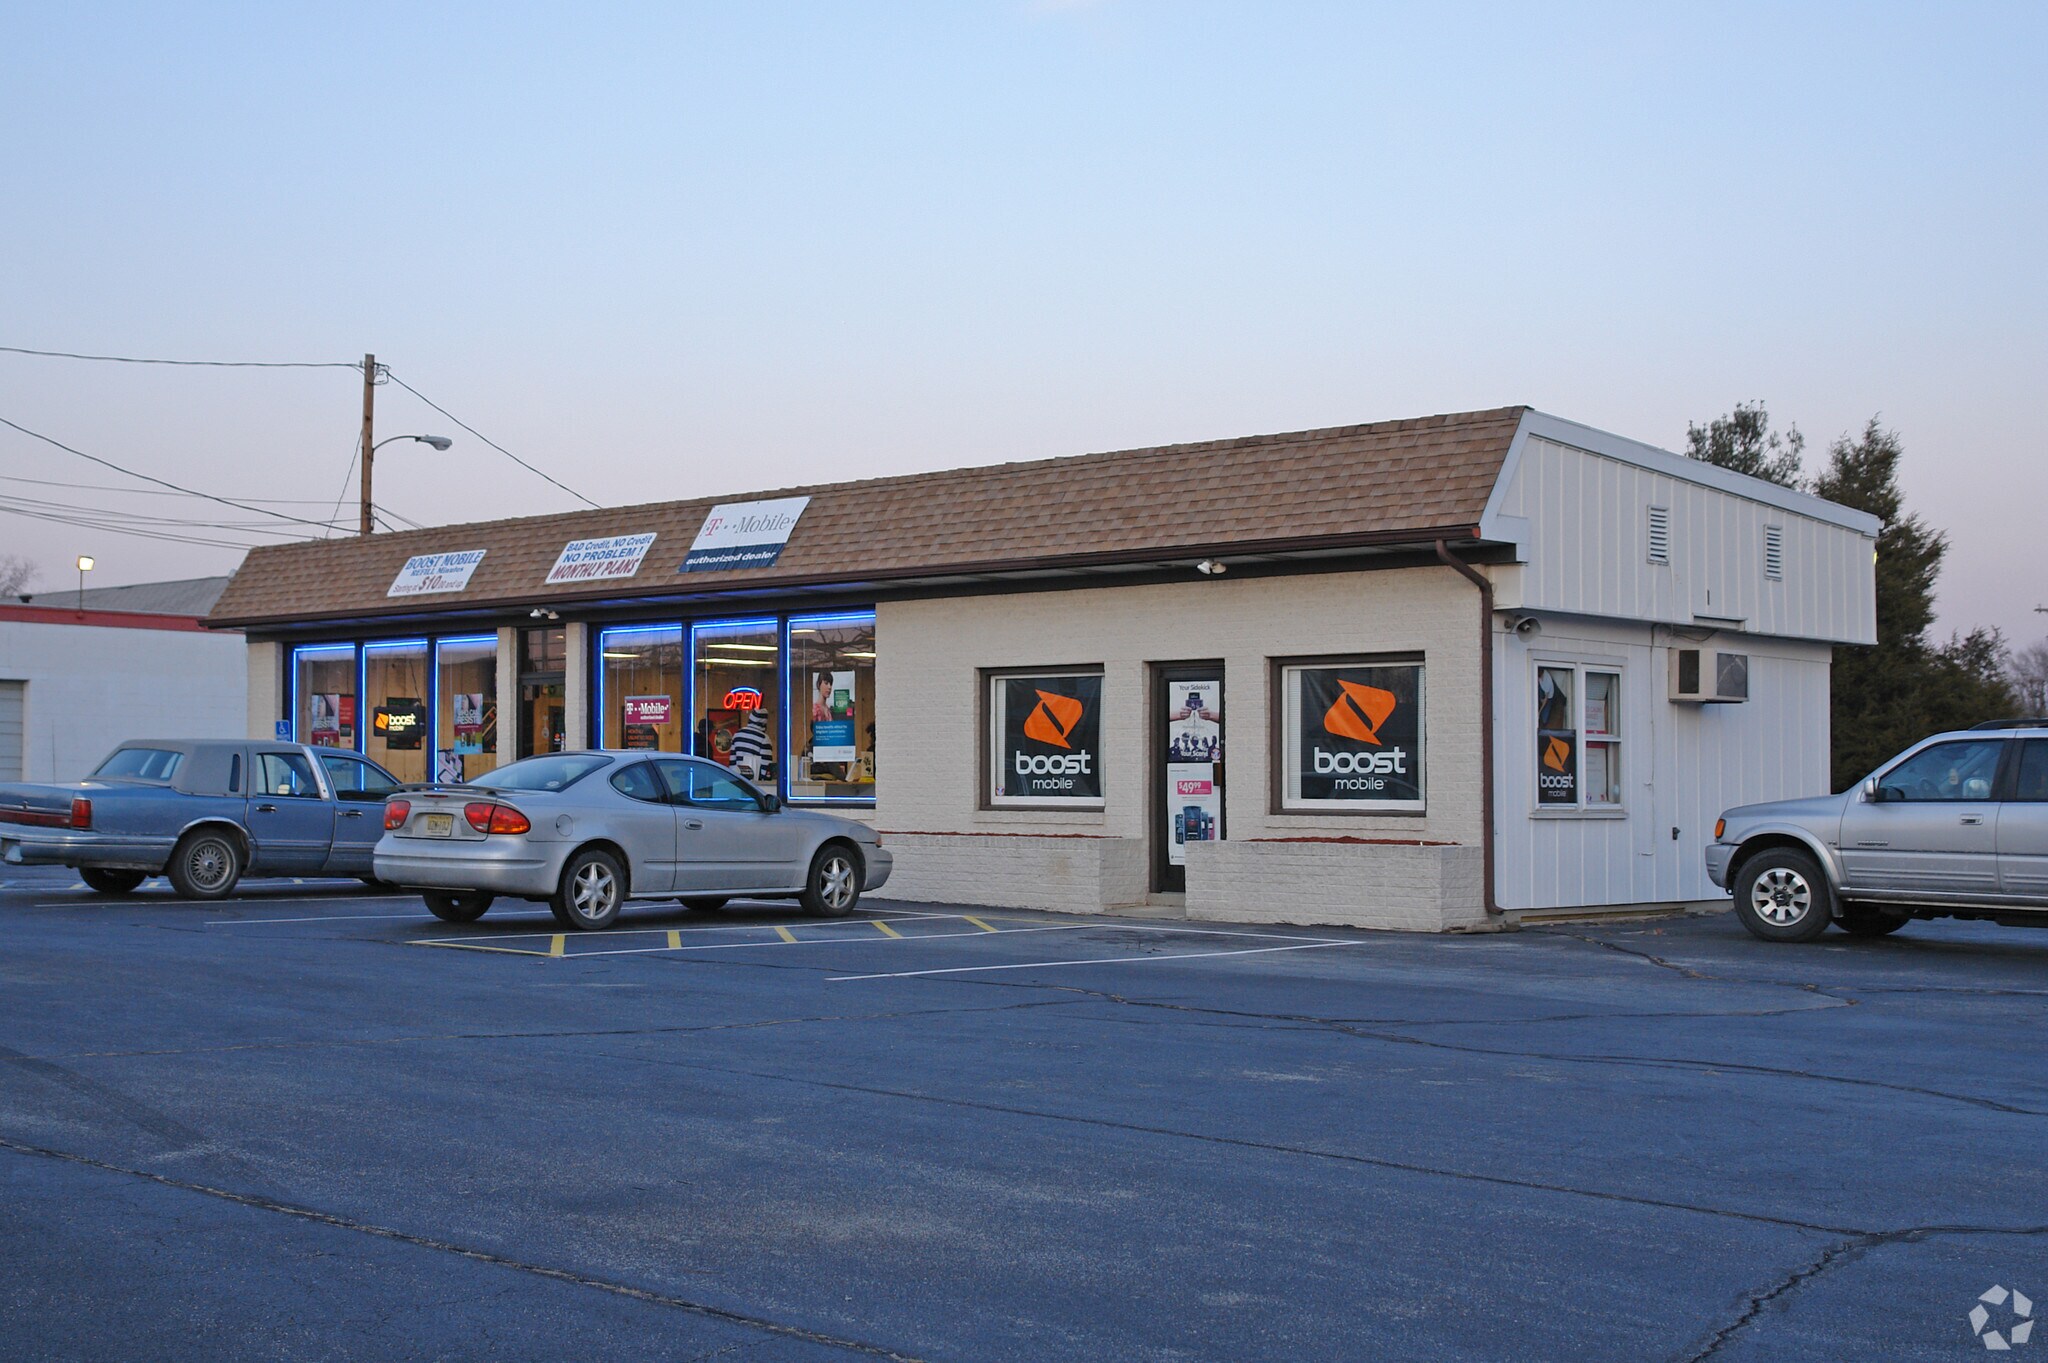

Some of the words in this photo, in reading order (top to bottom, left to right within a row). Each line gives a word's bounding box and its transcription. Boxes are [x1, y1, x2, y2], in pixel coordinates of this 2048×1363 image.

[566, 543, 585, 552] BAD
[612, 538, 627, 548] NO
[627, 535, 653, 546] Credit
[405, 555, 443, 570] BOOST
[441, 551, 484, 567] MOBILE
[562, 553, 581, 563] NO
[686, 553, 741, 565] authorized
[741, 551, 777, 561] dealer
[410, 567, 436, 577] REFILL
[550, 561, 604, 580] MONTHLY
[601, 558, 640, 576] PLANS
[723, 691, 763, 710] OPEN
[388, 712, 417, 726] boost
[1015, 749, 1092, 775] boost
[1313, 746, 1407, 774] boost
[1032, 777, 1074, 790] mobile
[1334, 777, 1385, 790] mobile
[1540, 772, 1574, 788] boost
[1547, 789, 1568, 797] mobile
